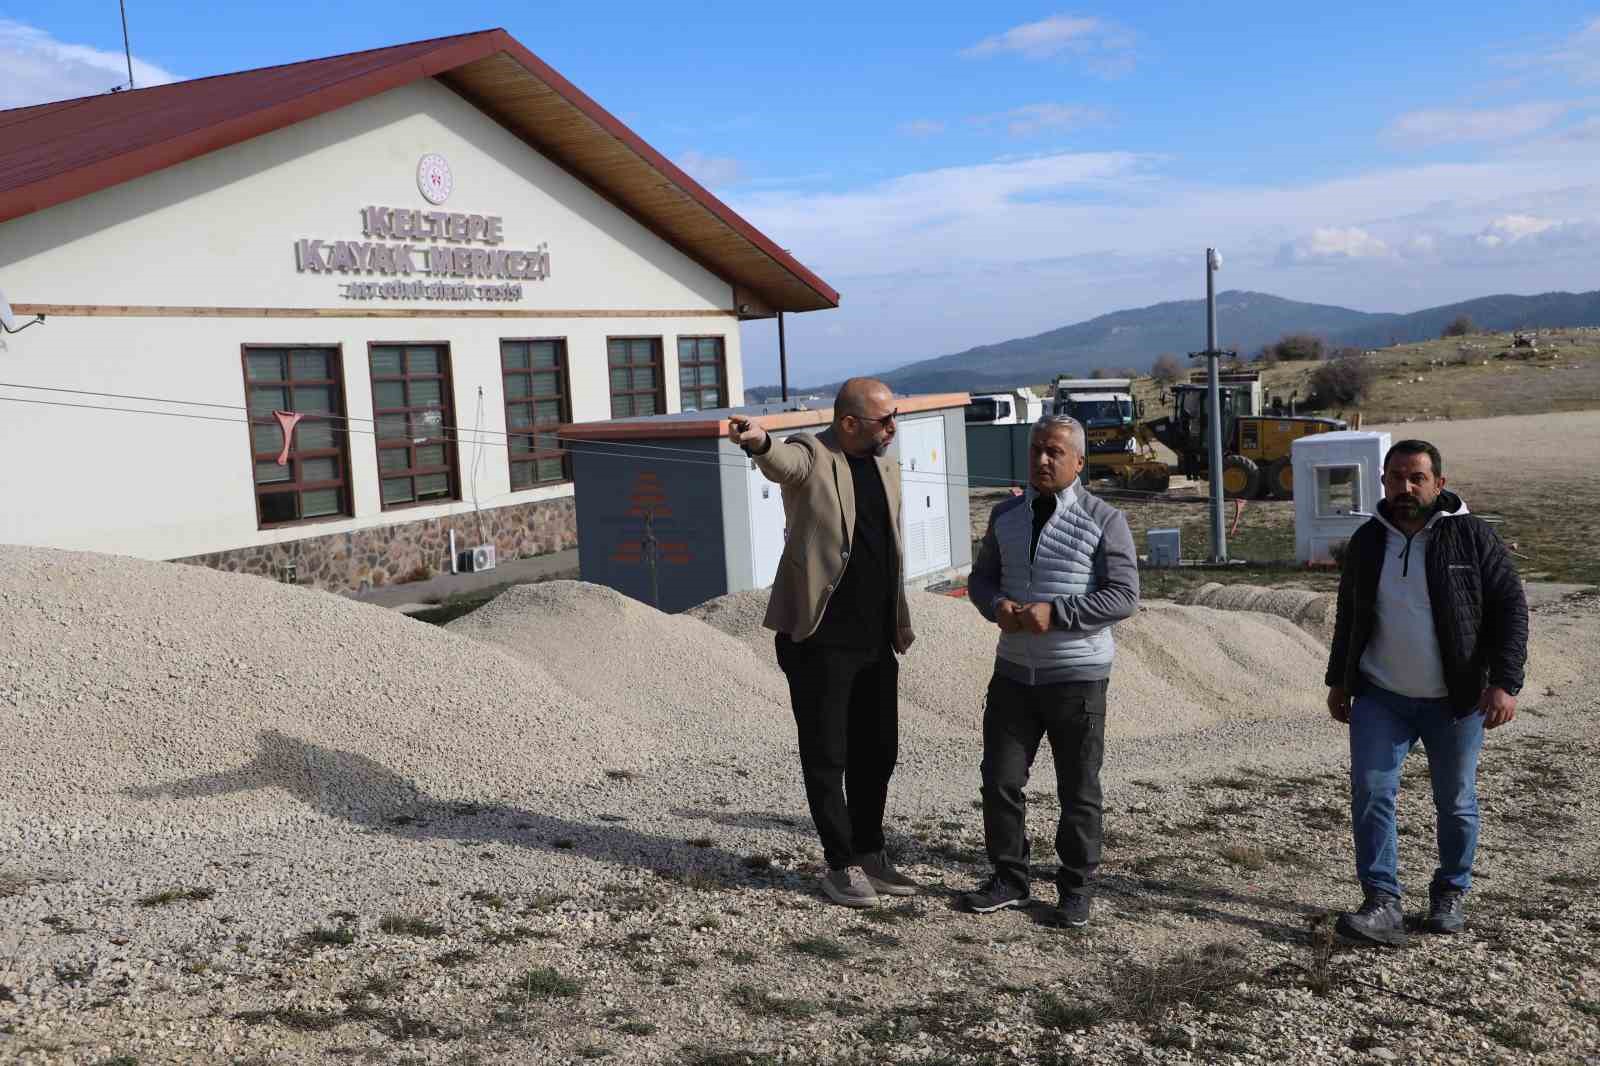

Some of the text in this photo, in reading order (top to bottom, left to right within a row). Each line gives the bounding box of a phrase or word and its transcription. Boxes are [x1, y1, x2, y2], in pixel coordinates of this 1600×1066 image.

[364, 206, 503, 243] KELTEPE
[297, 239, 550, 279] KAYAK MERKEZİ
